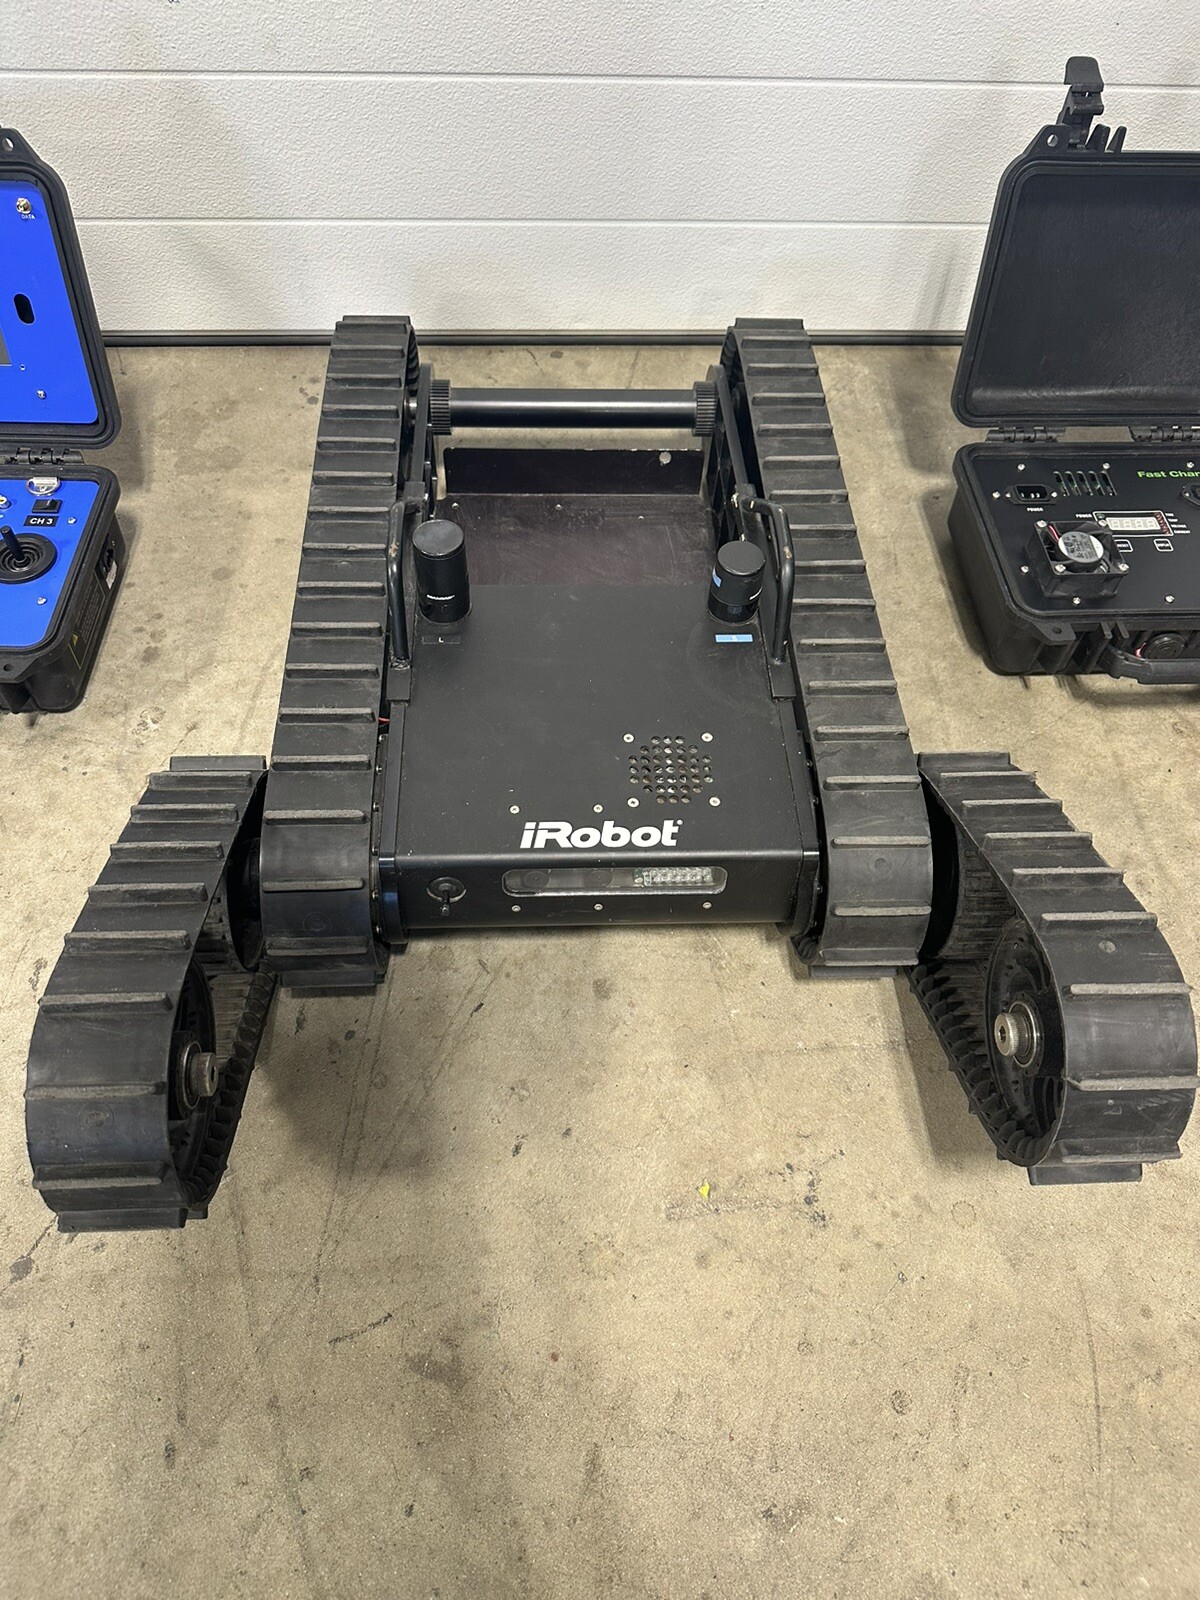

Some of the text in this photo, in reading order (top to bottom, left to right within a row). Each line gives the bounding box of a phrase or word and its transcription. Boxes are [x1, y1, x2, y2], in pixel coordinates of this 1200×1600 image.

[1137, 470, 1167, 478] Fast
[29, 517, 54, 525] CH 3
[519, 819, 680, 849] iRobot
